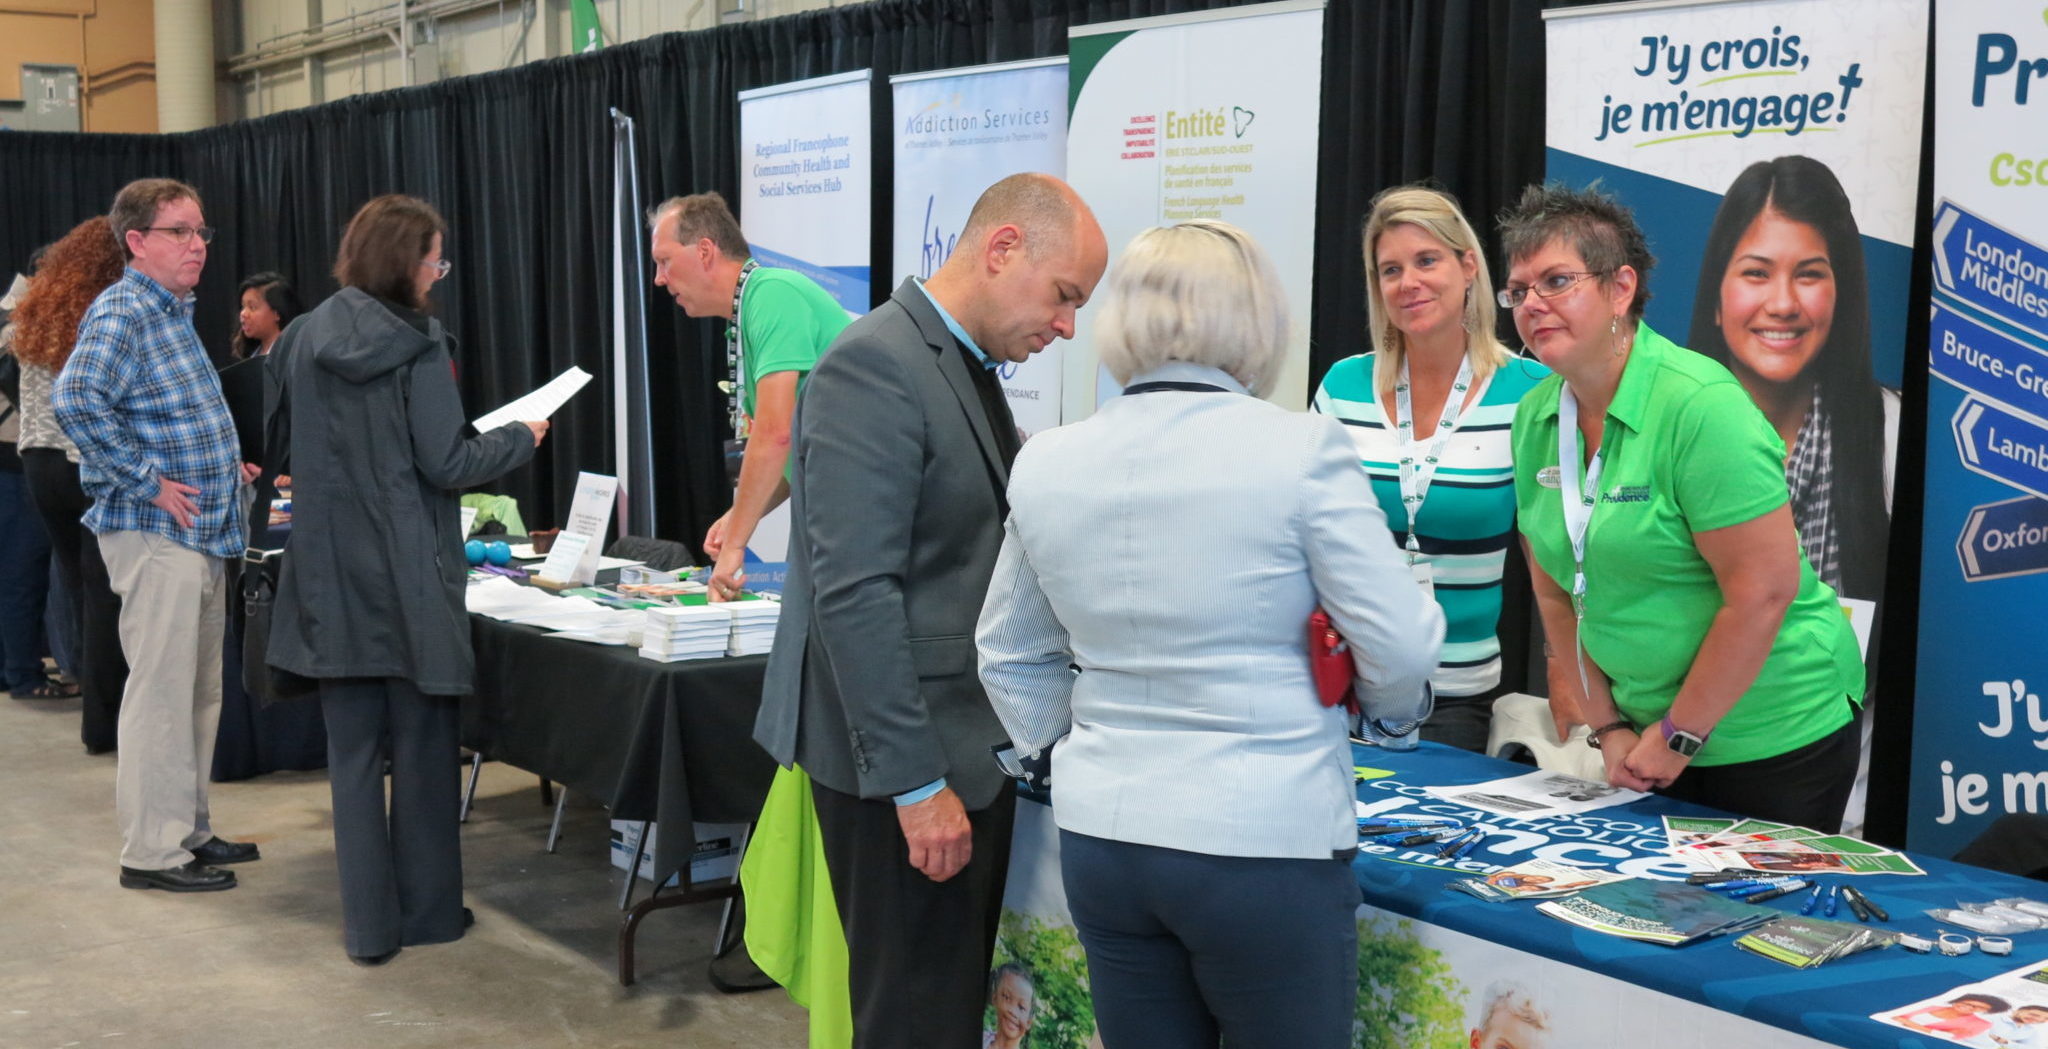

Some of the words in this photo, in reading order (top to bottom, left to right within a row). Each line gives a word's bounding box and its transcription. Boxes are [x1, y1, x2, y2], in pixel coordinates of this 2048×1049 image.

[1633, 34, 1691, 86] J'y
[1700, 25, 1810, 72] crois,
[905, 114, 977, 135] Addiction
[984, 106, 1050, 129] Services
[1166, 106, 1226, 139] Entité
[1594, 94, 1633, 142] je
[755, 139, 792, 159] Regional
[793, 133, 849, 153] Francophone
[753, 160, 801, 178] Community
[803, 155, 831, 173] Health
[833, 153, 850, 170] and
[759, 181, 785, 198] Social
[786, 179, 822, 196] Services
[823, 176, 842, 193] Hub
[1935, 759, 1990, 825] je
